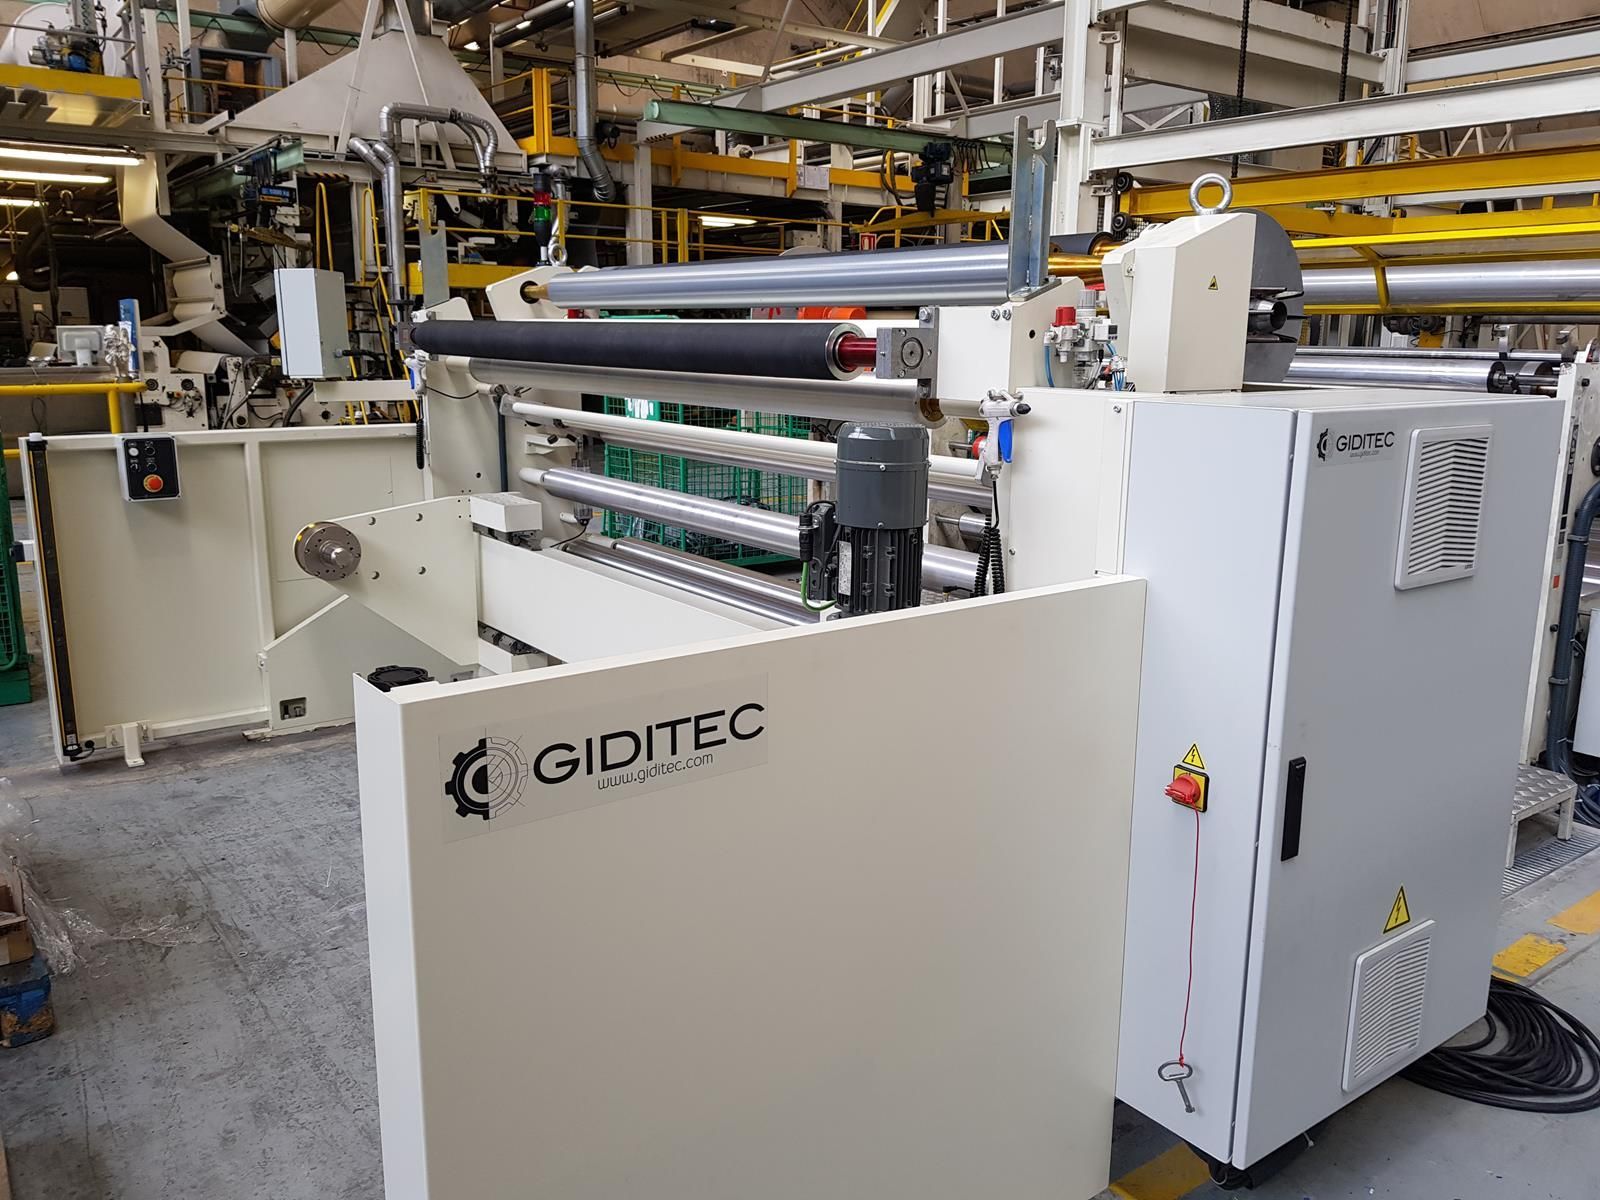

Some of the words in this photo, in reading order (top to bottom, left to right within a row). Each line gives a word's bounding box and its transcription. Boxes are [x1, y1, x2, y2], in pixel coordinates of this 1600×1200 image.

[1336, 431, 1395, 452] GIDITEC
[533, 703, 765, 785] GIDITEC
[597, 753, 714, 790] www.giditec.com
